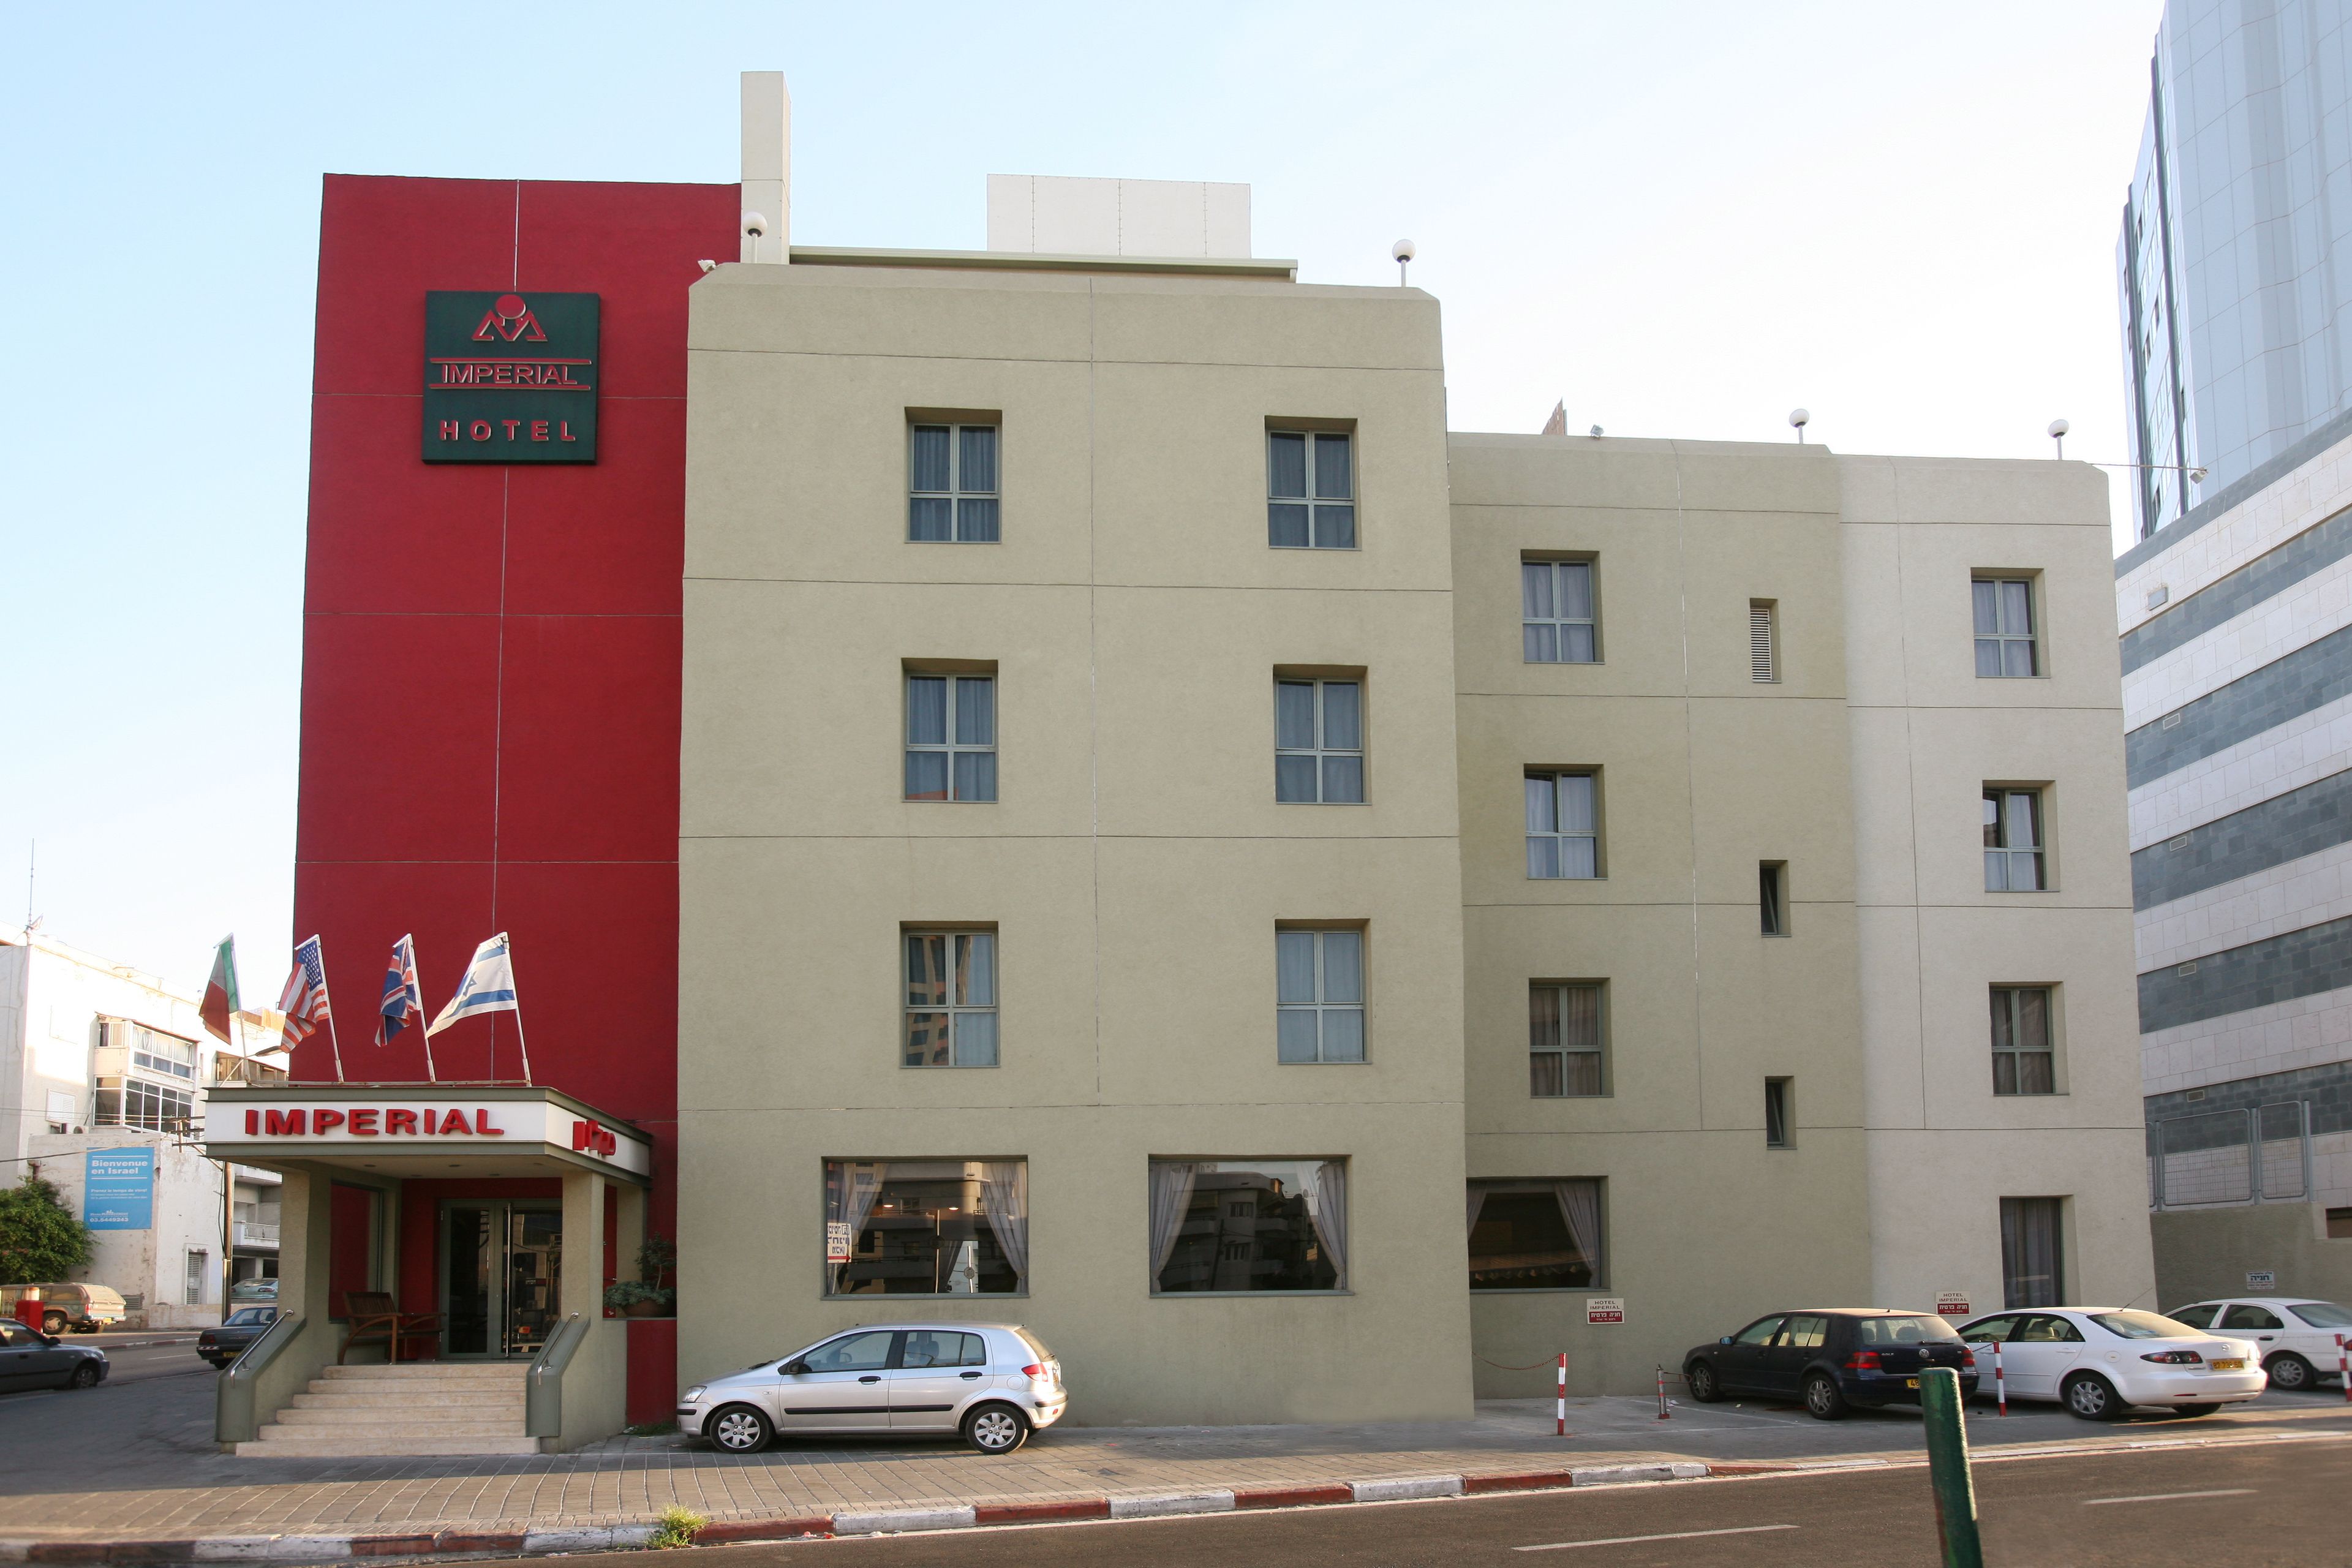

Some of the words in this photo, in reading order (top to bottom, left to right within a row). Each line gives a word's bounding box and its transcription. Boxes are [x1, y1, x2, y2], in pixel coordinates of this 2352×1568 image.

[442, 364, 578, 385] IMPERIAL
[439, 420, 576, 442] HOTEL
[245, 1108, 505, 1136] IMPERIAL
